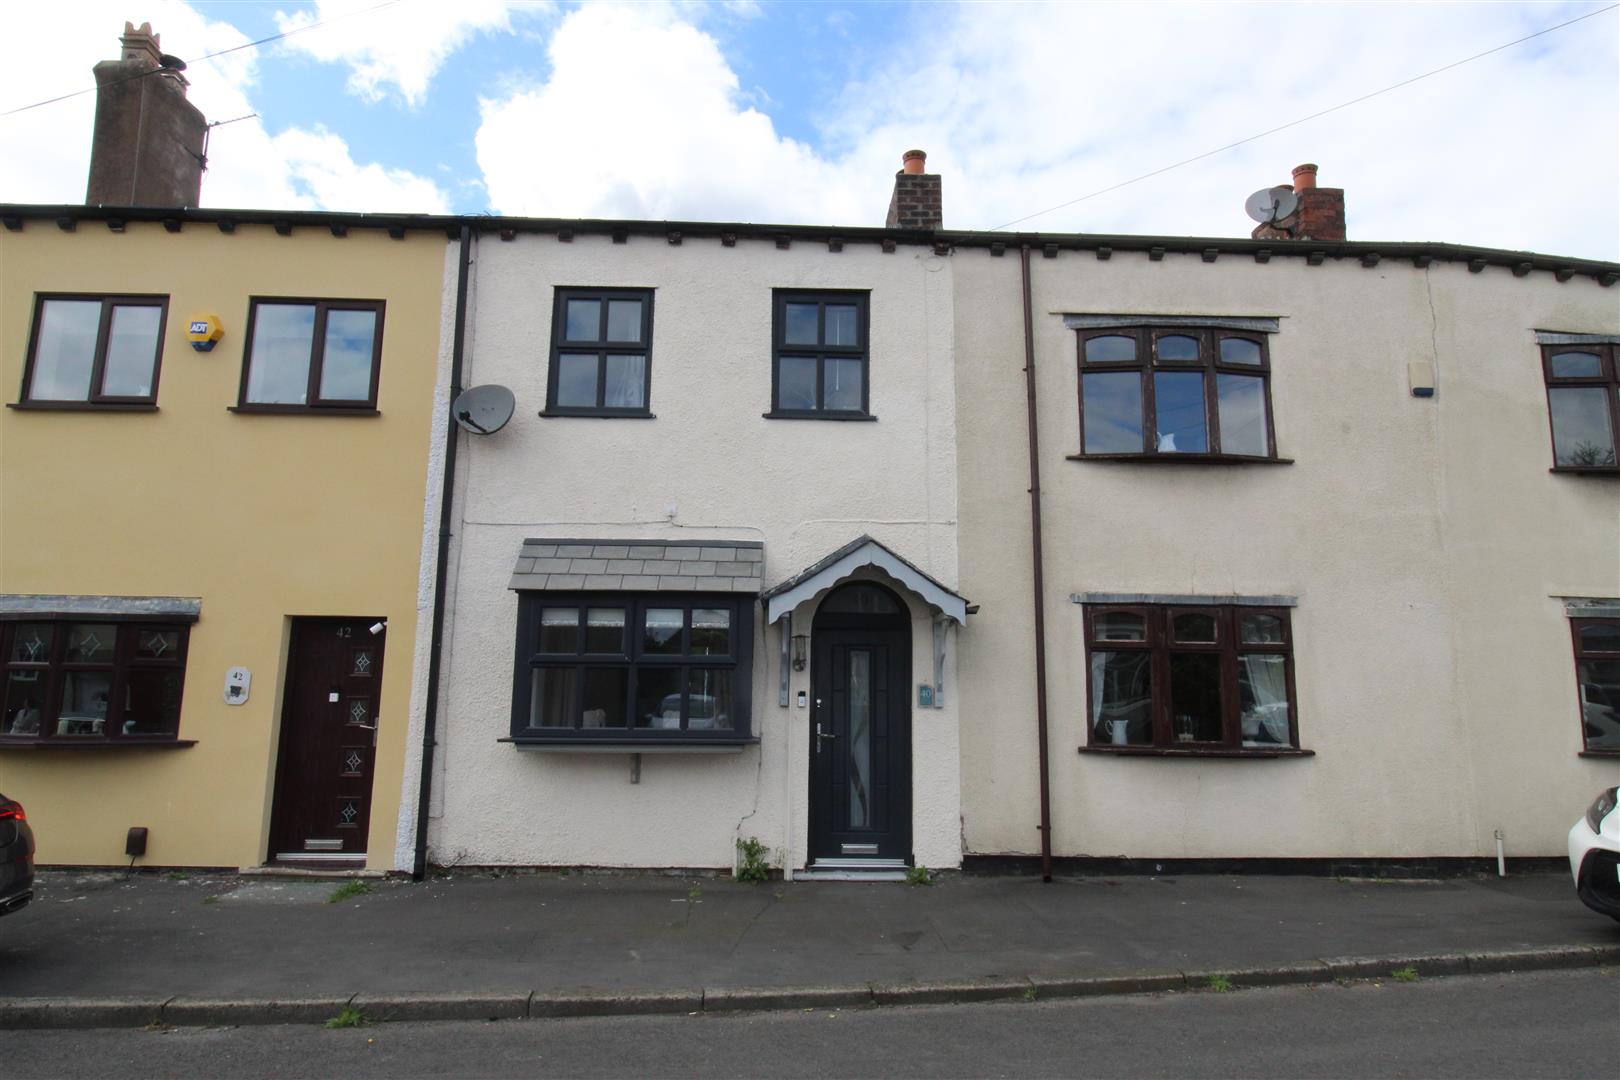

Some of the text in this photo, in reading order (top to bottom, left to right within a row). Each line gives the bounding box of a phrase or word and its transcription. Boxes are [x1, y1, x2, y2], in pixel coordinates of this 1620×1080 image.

[191, 322, 208, 333] ADT
[336, 627, 351, 638] 42
[232, 671, 243, 681] 42
